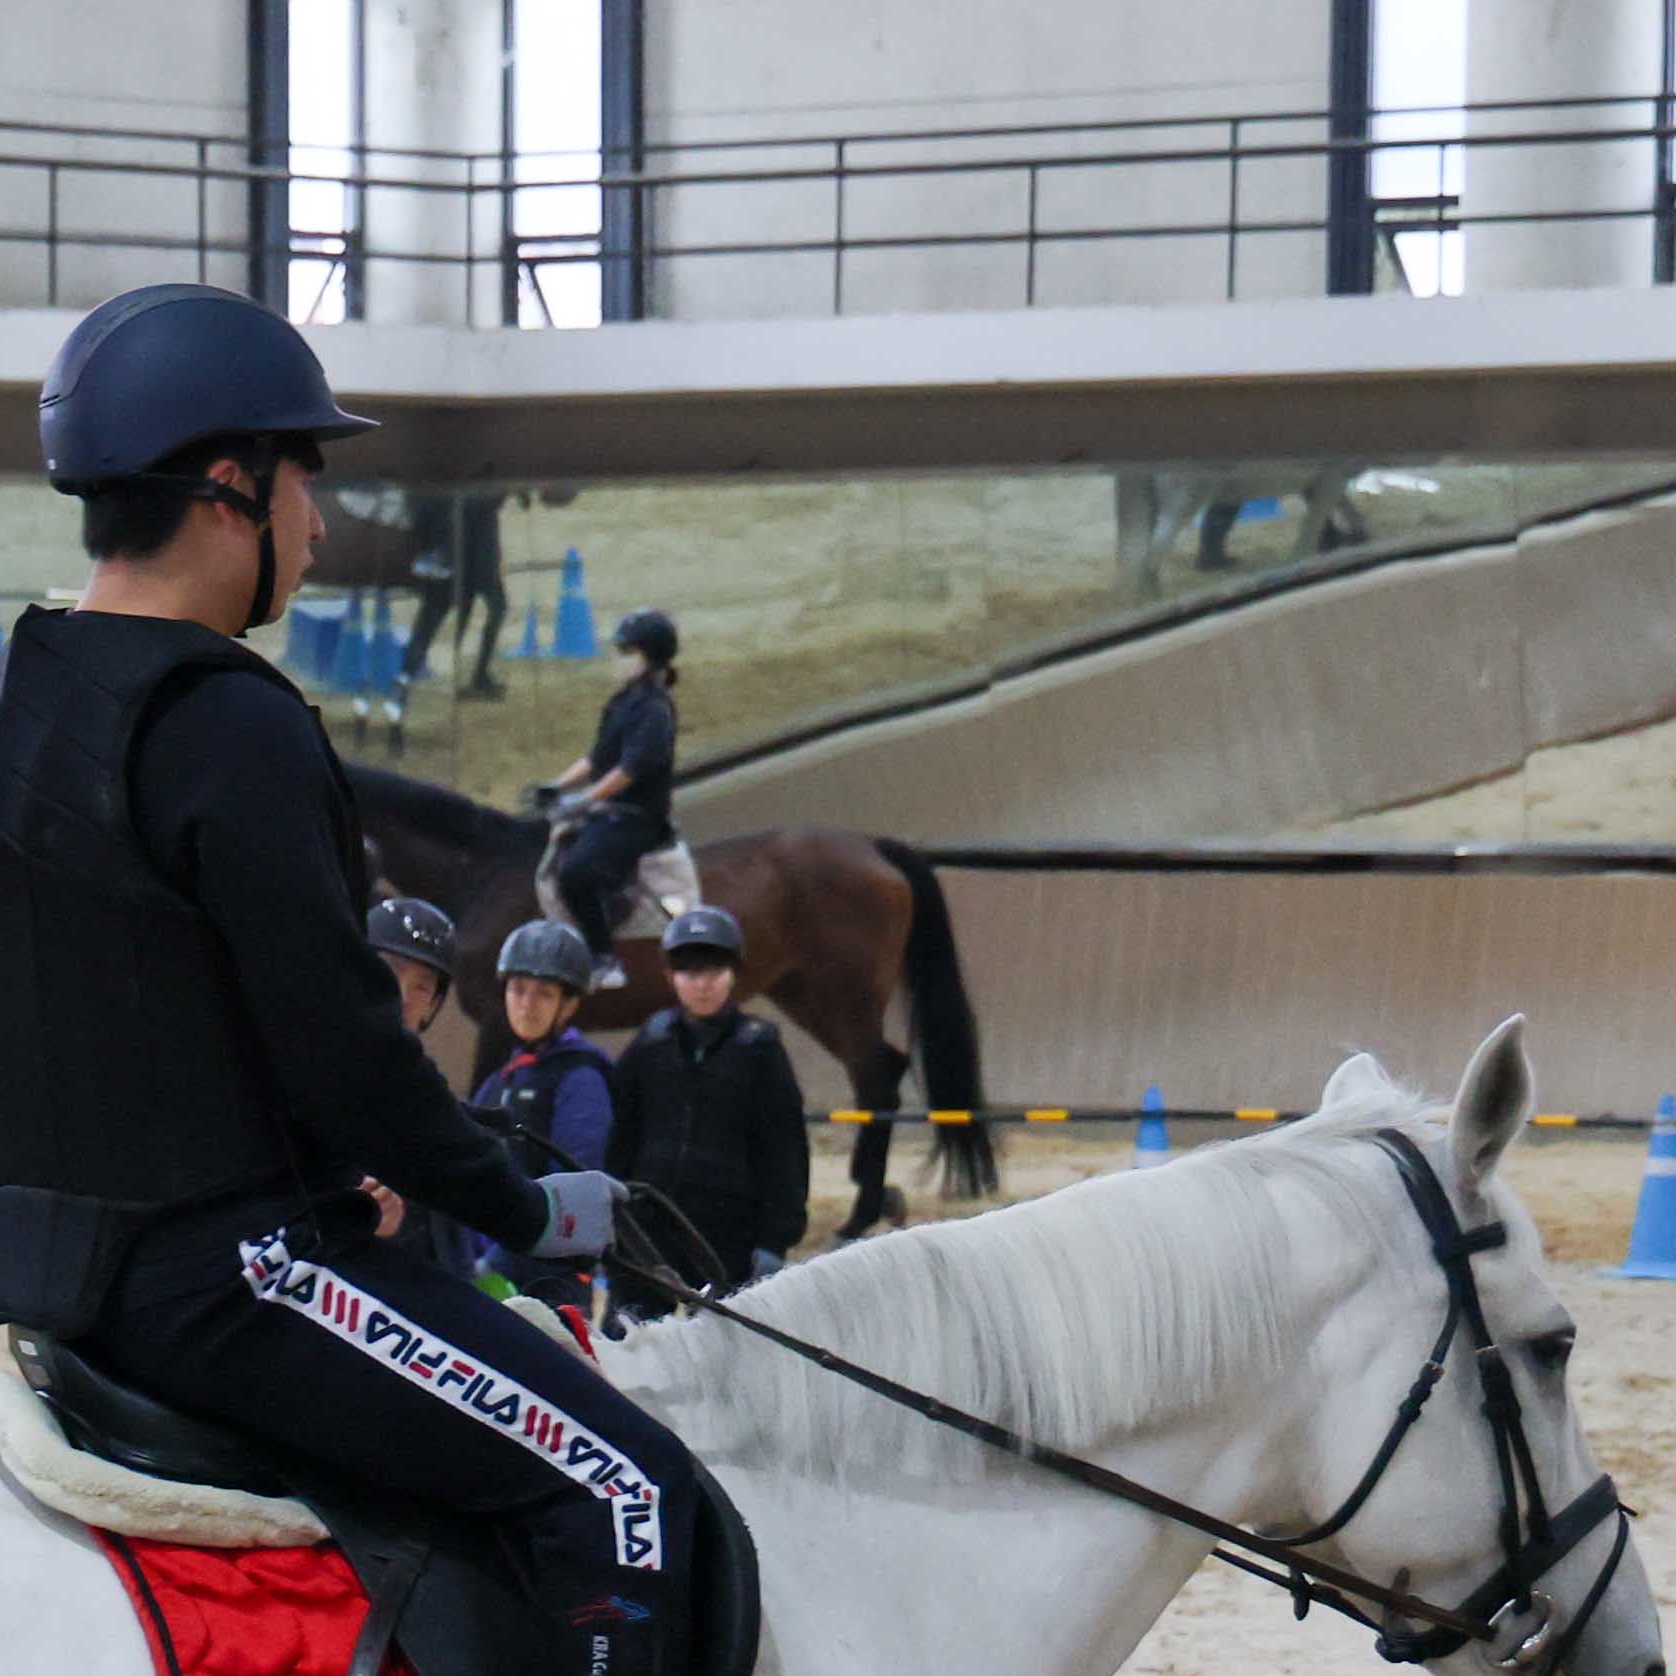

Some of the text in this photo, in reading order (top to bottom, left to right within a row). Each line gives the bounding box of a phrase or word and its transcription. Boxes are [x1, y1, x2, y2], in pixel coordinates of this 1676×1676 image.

[366, 1310, 448, 1380] FILA
[437, 1359, 521, 1425] FILA
[567, 1436, 641, 1497] FILA
